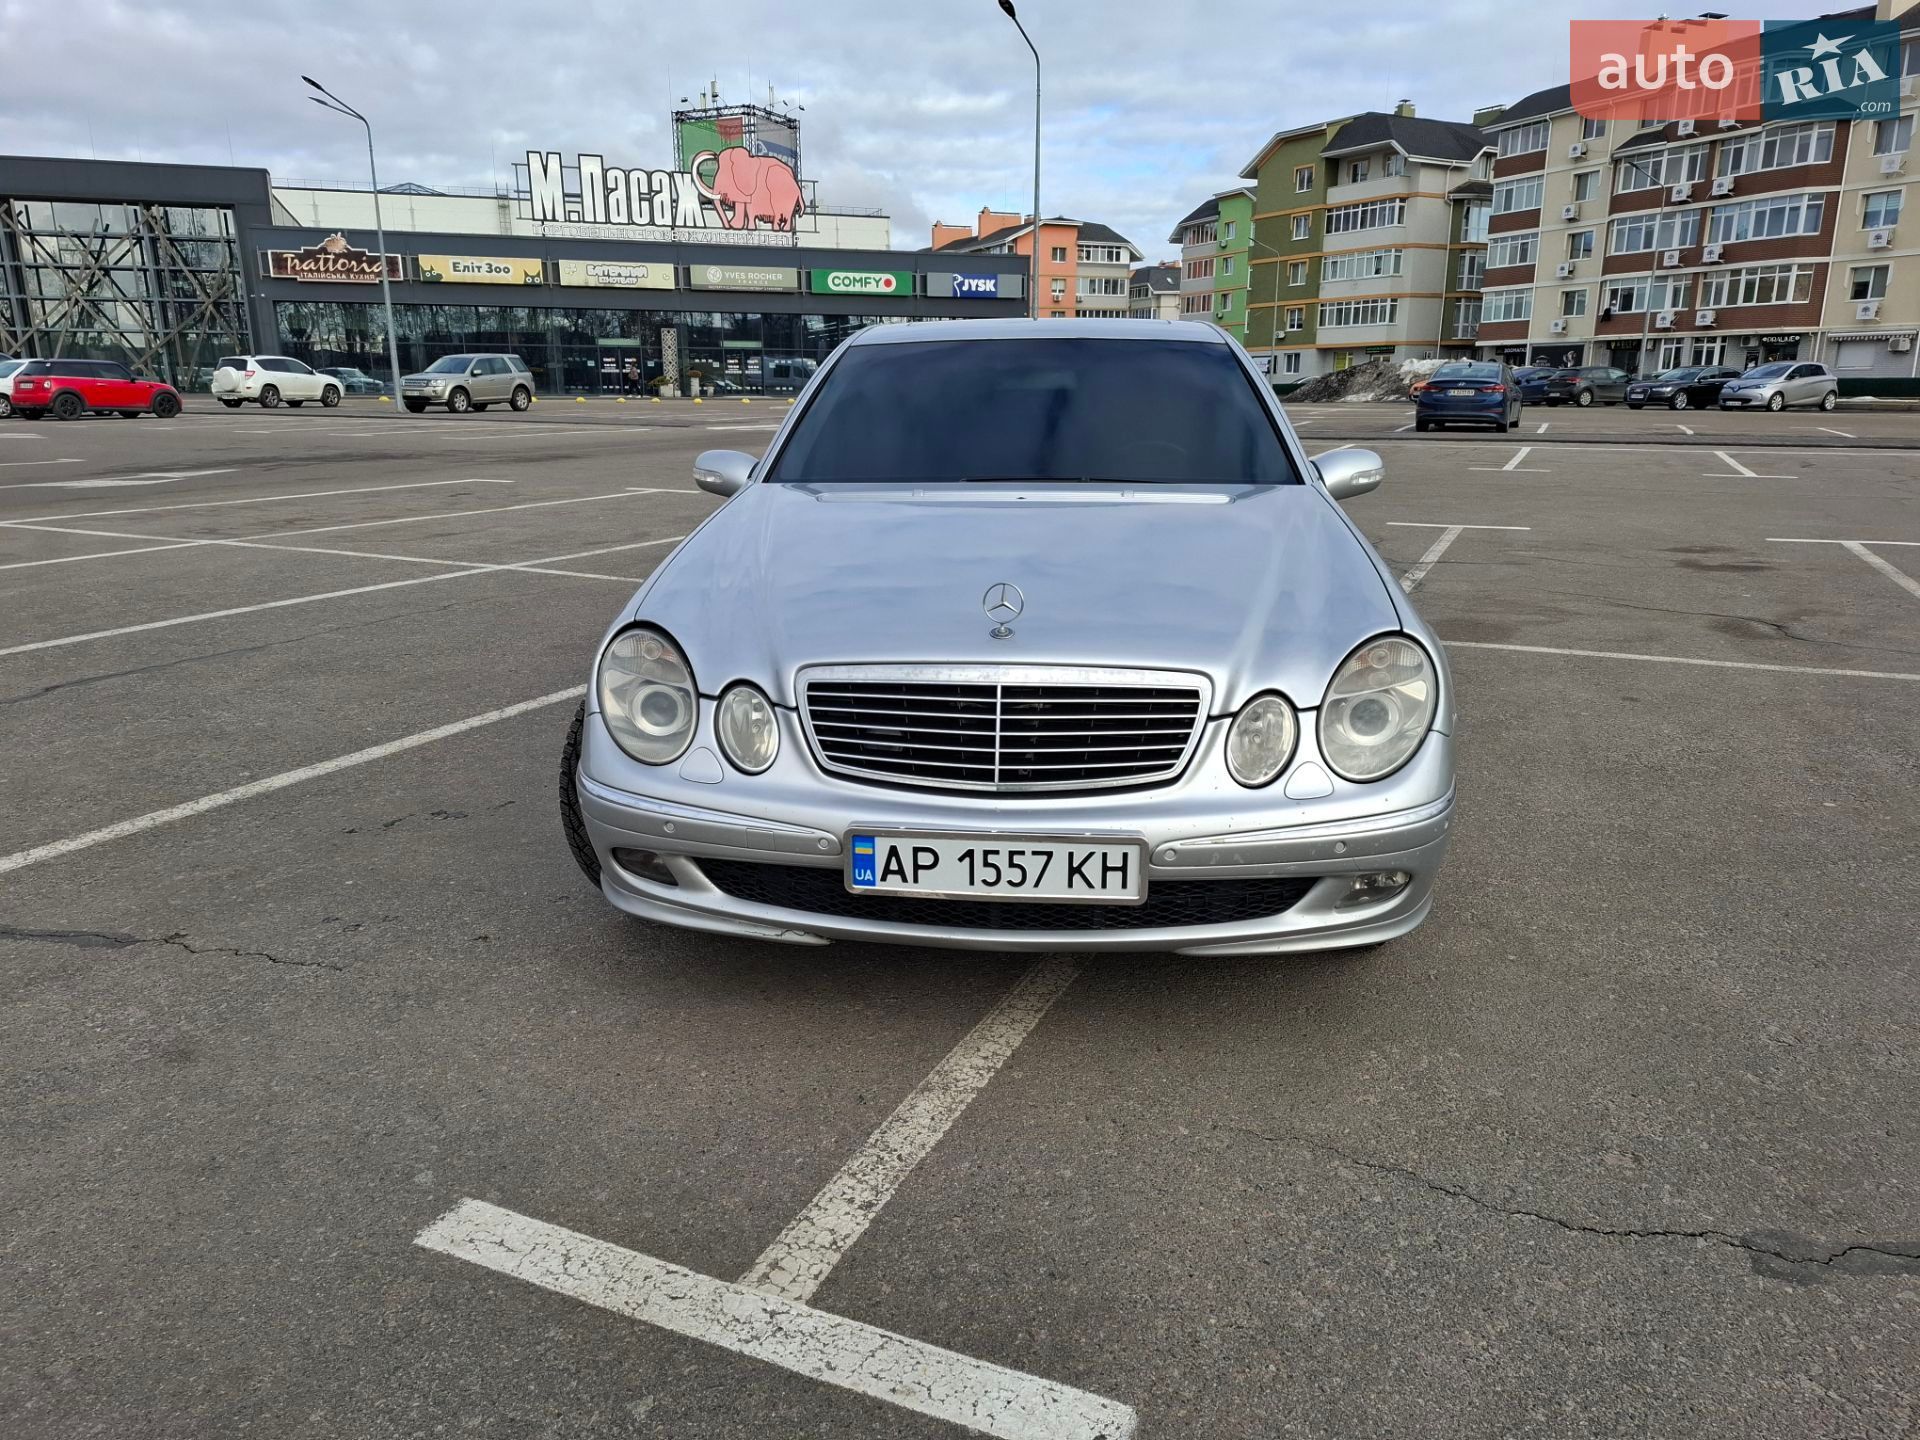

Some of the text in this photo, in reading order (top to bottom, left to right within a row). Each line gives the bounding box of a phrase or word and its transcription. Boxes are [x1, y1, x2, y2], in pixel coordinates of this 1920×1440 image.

[283, 252, 388, 275] Trattoria
[452, 261, 511, 275] Еліт Зоо
[724, 271, 783, 281] YVES ROCHER
[831, 275, 882, 289] COMFY
[961, 279, 996, 292] JYSK
[879, 844, 1128, 889] AP 1557 KH
[855, 868, 873, 881] UA
